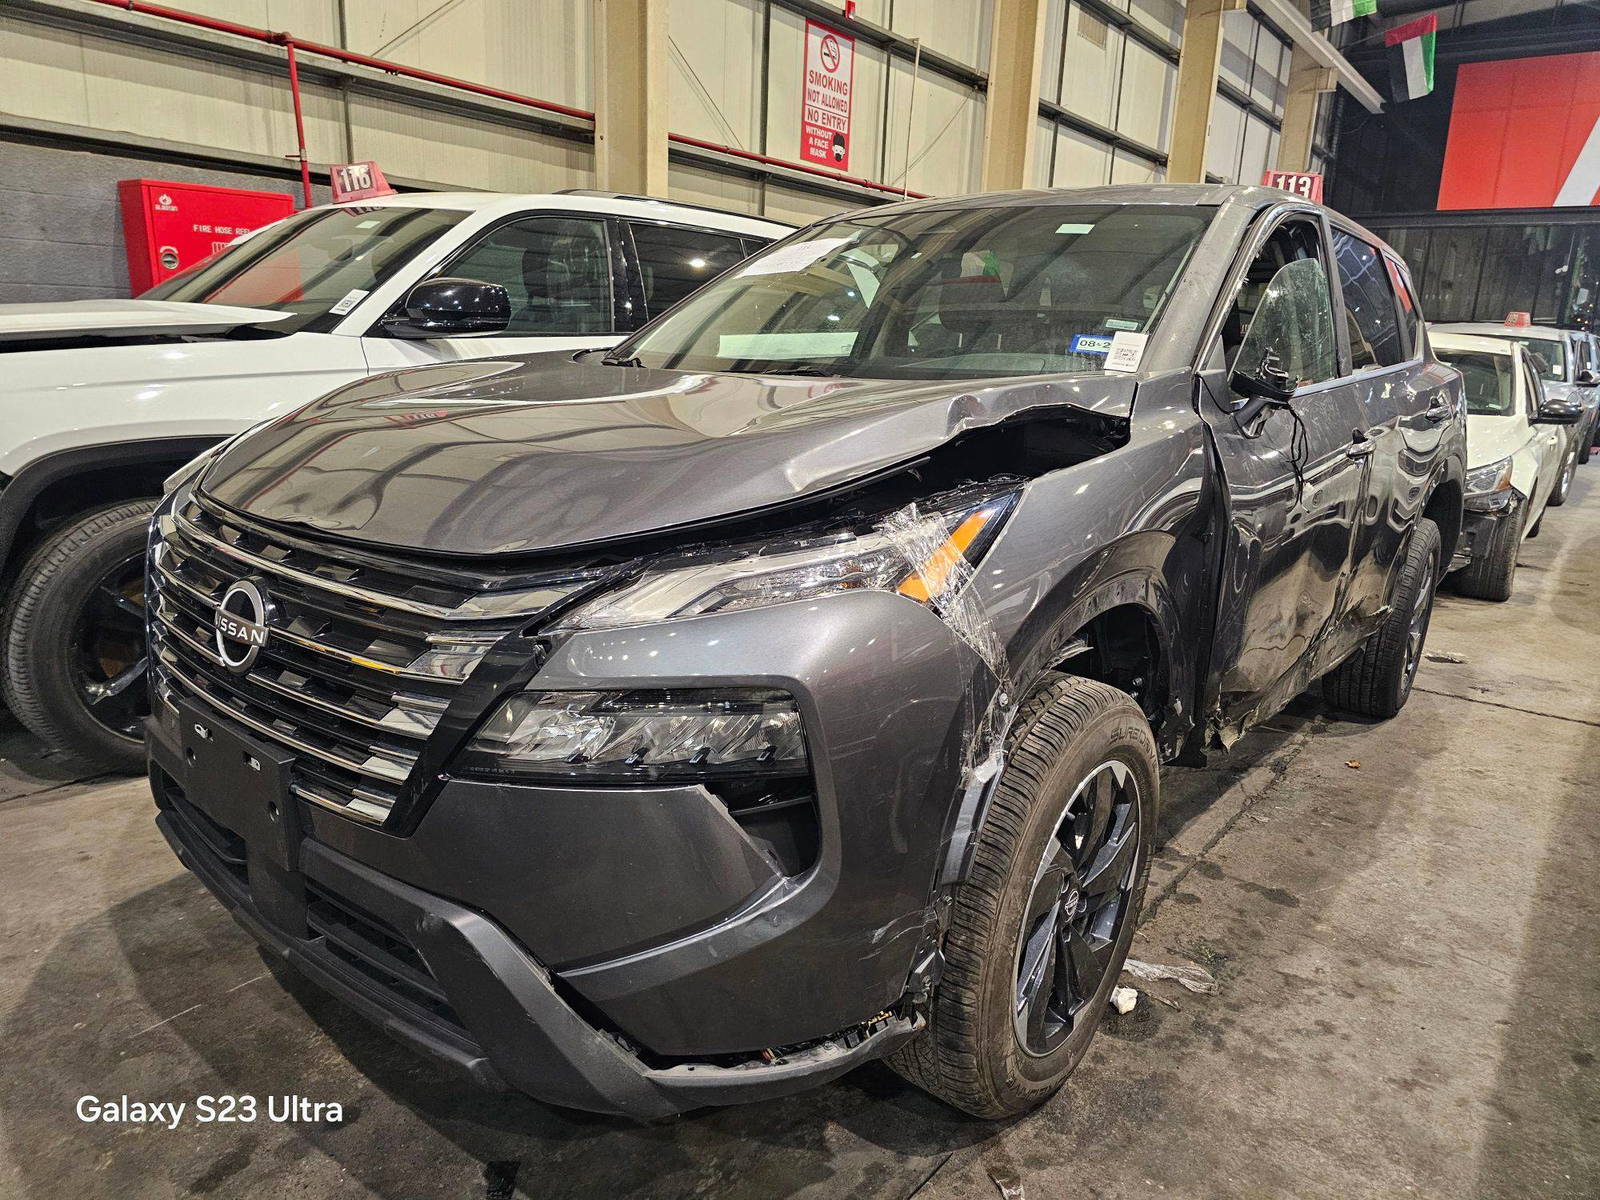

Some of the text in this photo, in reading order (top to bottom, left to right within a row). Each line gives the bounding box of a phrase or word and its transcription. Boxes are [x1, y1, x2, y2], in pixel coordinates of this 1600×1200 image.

[809, 70, 848, 96] SMOKING
[807, 88, 847, 113] NOT ALLOWED
[807, 108, 847, 131] NO ENTRY
[805, 125, 833, 139] WITHOUT
[814, 138, 829, 149] FACE
[809, 147, 827, 158] MASK
[341, 165, 371, 192] 116
[1277, 175, 1312, 198] 113
[193, 224, 212, 233] FIRE
[214, 226, 233, 235] HOSE
